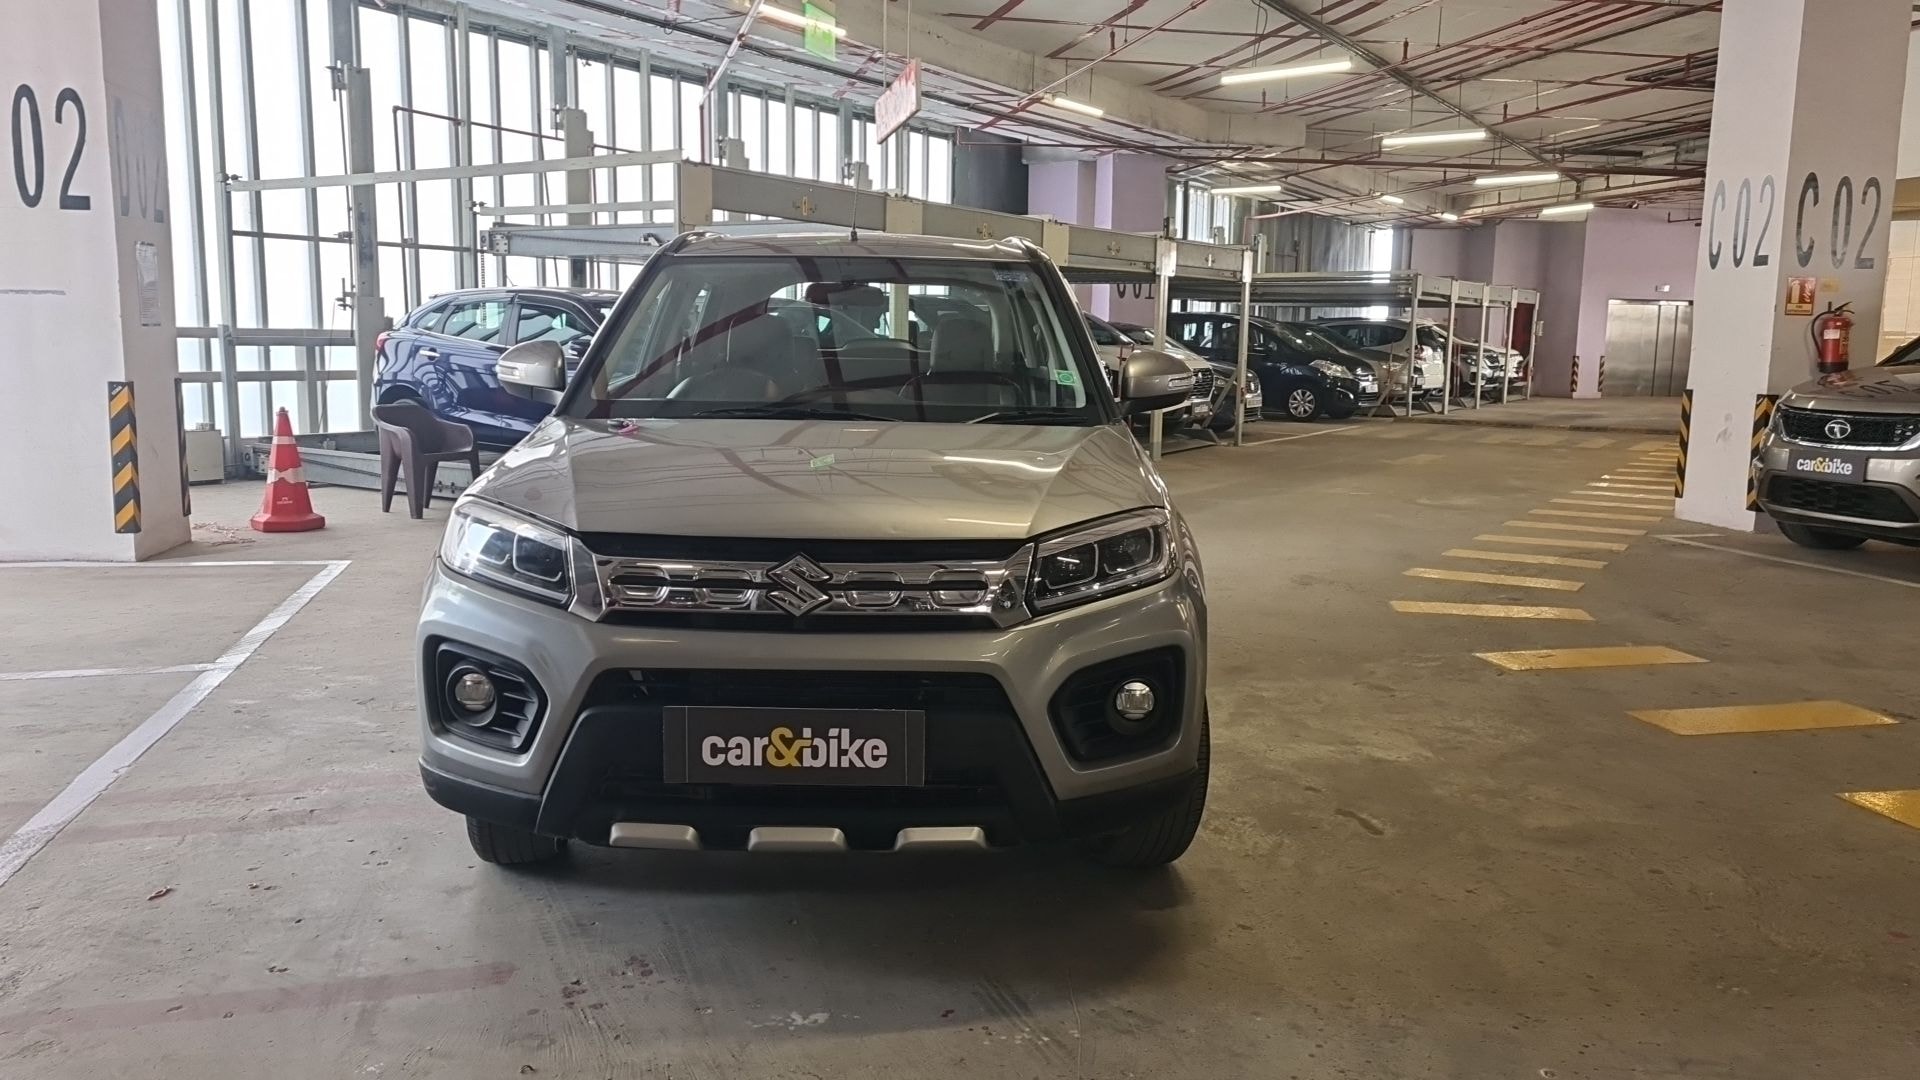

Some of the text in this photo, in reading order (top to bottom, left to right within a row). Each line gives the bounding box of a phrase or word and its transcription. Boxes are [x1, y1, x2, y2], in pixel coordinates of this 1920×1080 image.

[12, 83, 91, 211] 02
[1796, 456, 1853, 475] car&bike
[701, 726, 889, 769] car&bike
